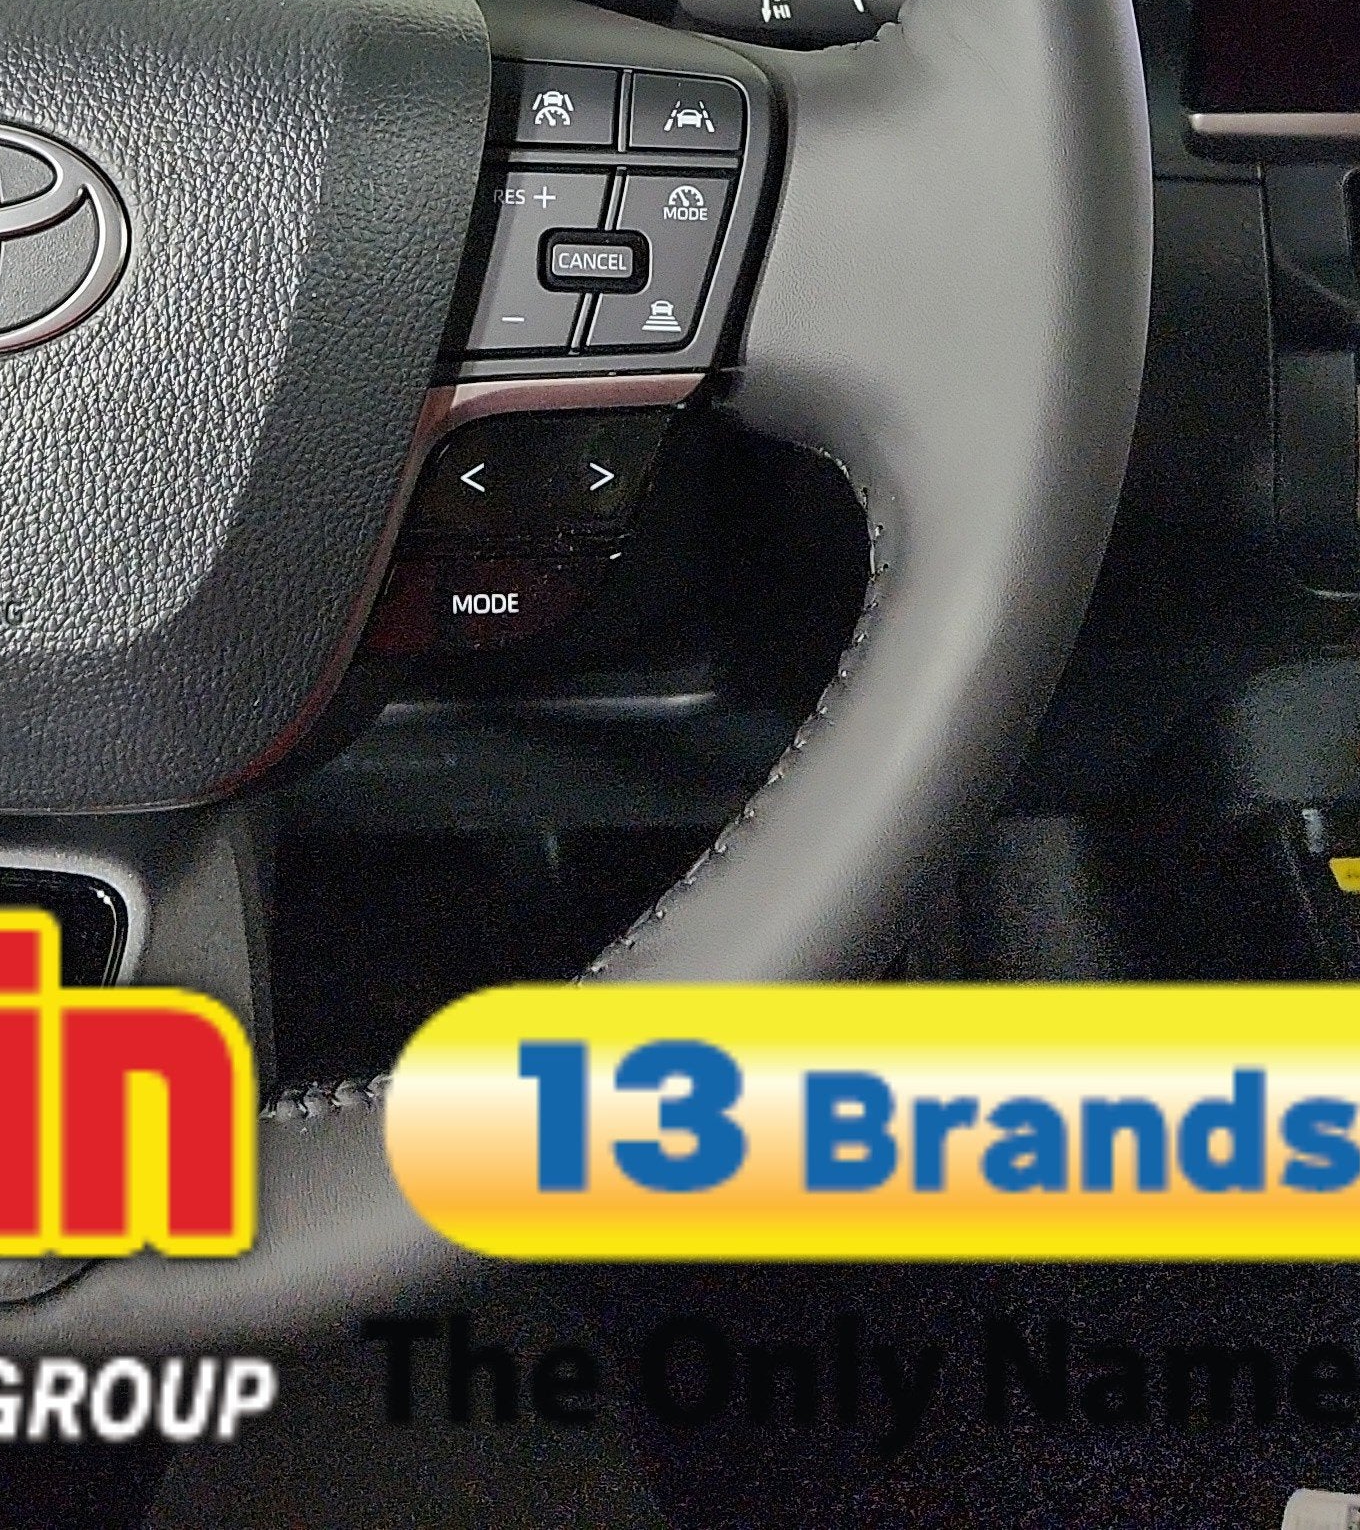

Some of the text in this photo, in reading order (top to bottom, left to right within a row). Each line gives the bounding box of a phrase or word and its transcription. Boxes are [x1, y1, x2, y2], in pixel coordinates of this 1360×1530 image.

[773, 5, 791, 19] HI
[493, 189, 525, 204] RES
[663, 207, 707, 221] MODE
[559, 252, 627, 271] CANCEL
[452, 593, 519, 614] MODE
